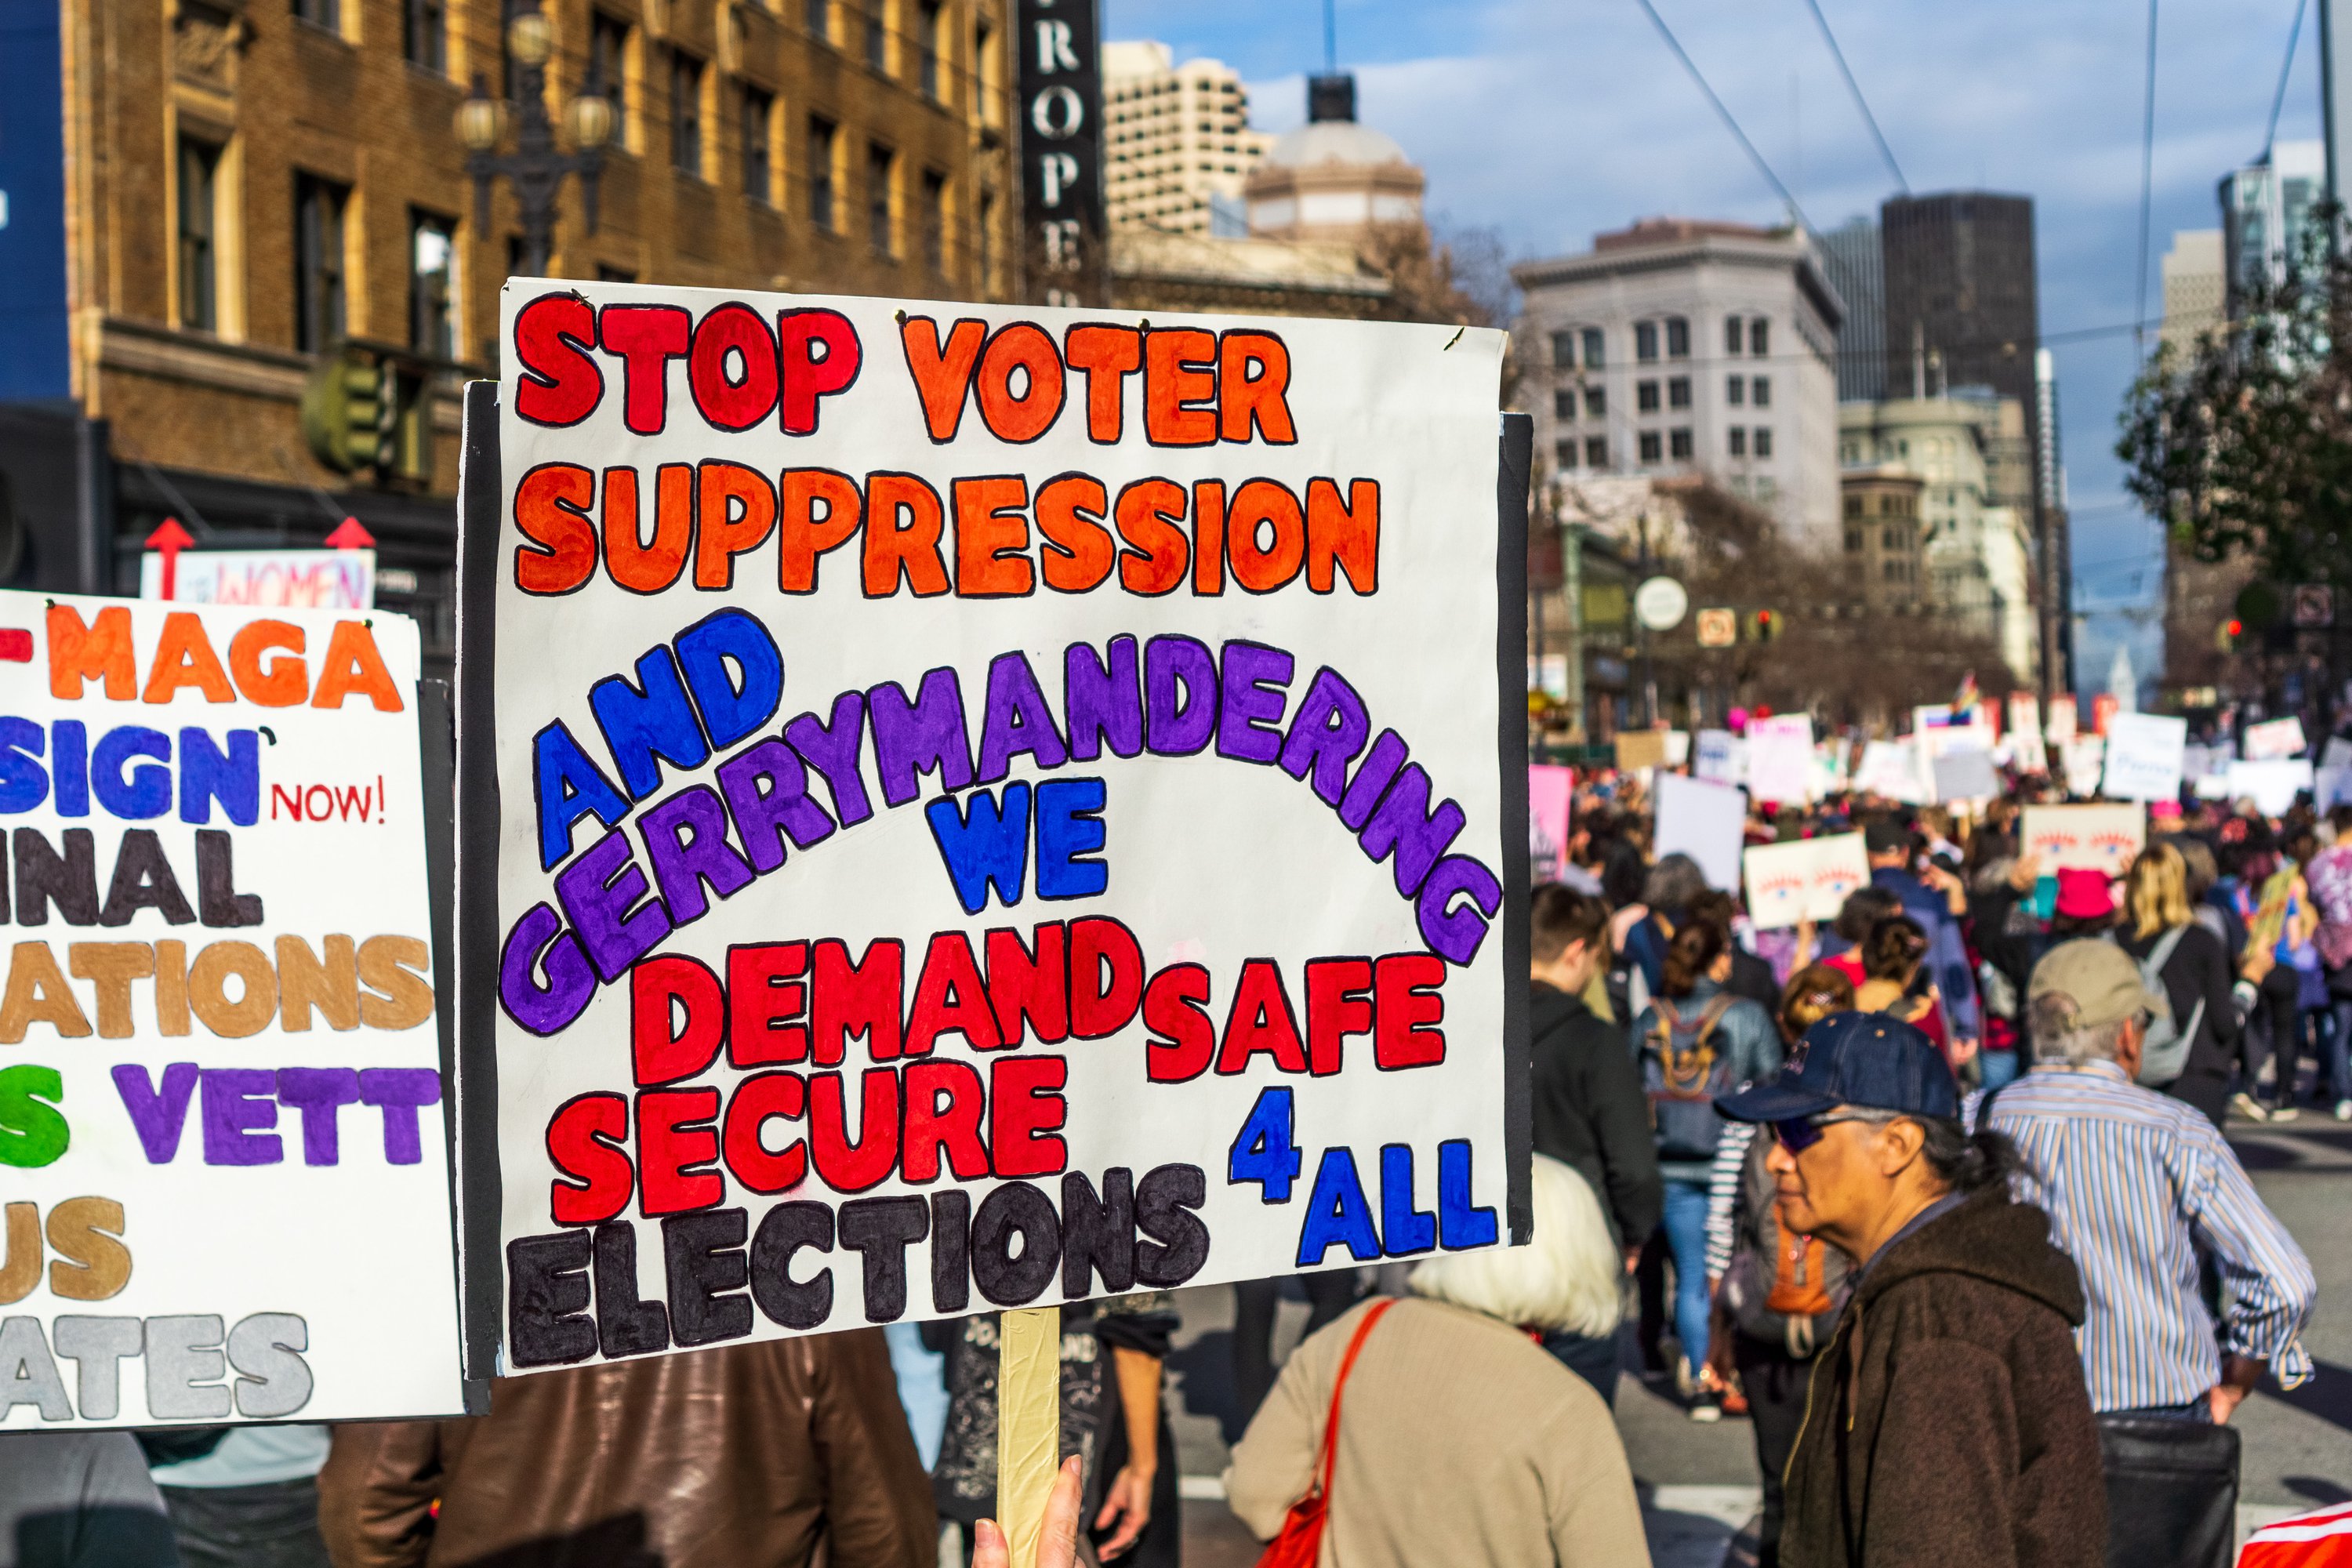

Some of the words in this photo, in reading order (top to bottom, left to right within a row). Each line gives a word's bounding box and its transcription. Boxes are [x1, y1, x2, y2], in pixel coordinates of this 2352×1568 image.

[1032, 0, 1084, 307] ROPE
[514, 291, 862, 436] STOP
[898, 314, 1299, 448] VOTER
[514, 459, 1381, 599] SUPPRESSION
[271, 775, 385, 825] NOW!
[532, 606, 785, 873] AND
[0, 827, 263, 927] NAL
[498, 633, 1503, 1038] GERRYMANDERING
[924, 775, 1109, 916] WE
[0, 934, 435, 1044] ATIONS
[629, 915, 1145, 1089] DEMAND
[1142, 951, 1447, 1083] SAFE
[111, 1062, 441, 1167] VETT
[546, 1054, 1069, 1228] SECURE
[506, 1163, 1210, 1369] ELECTIONS
[1228, 1085, 1302, 1204] 4
[1295, 1138, 1500, 1269] ALL
[0, 1312, 314, 1421] ATES
